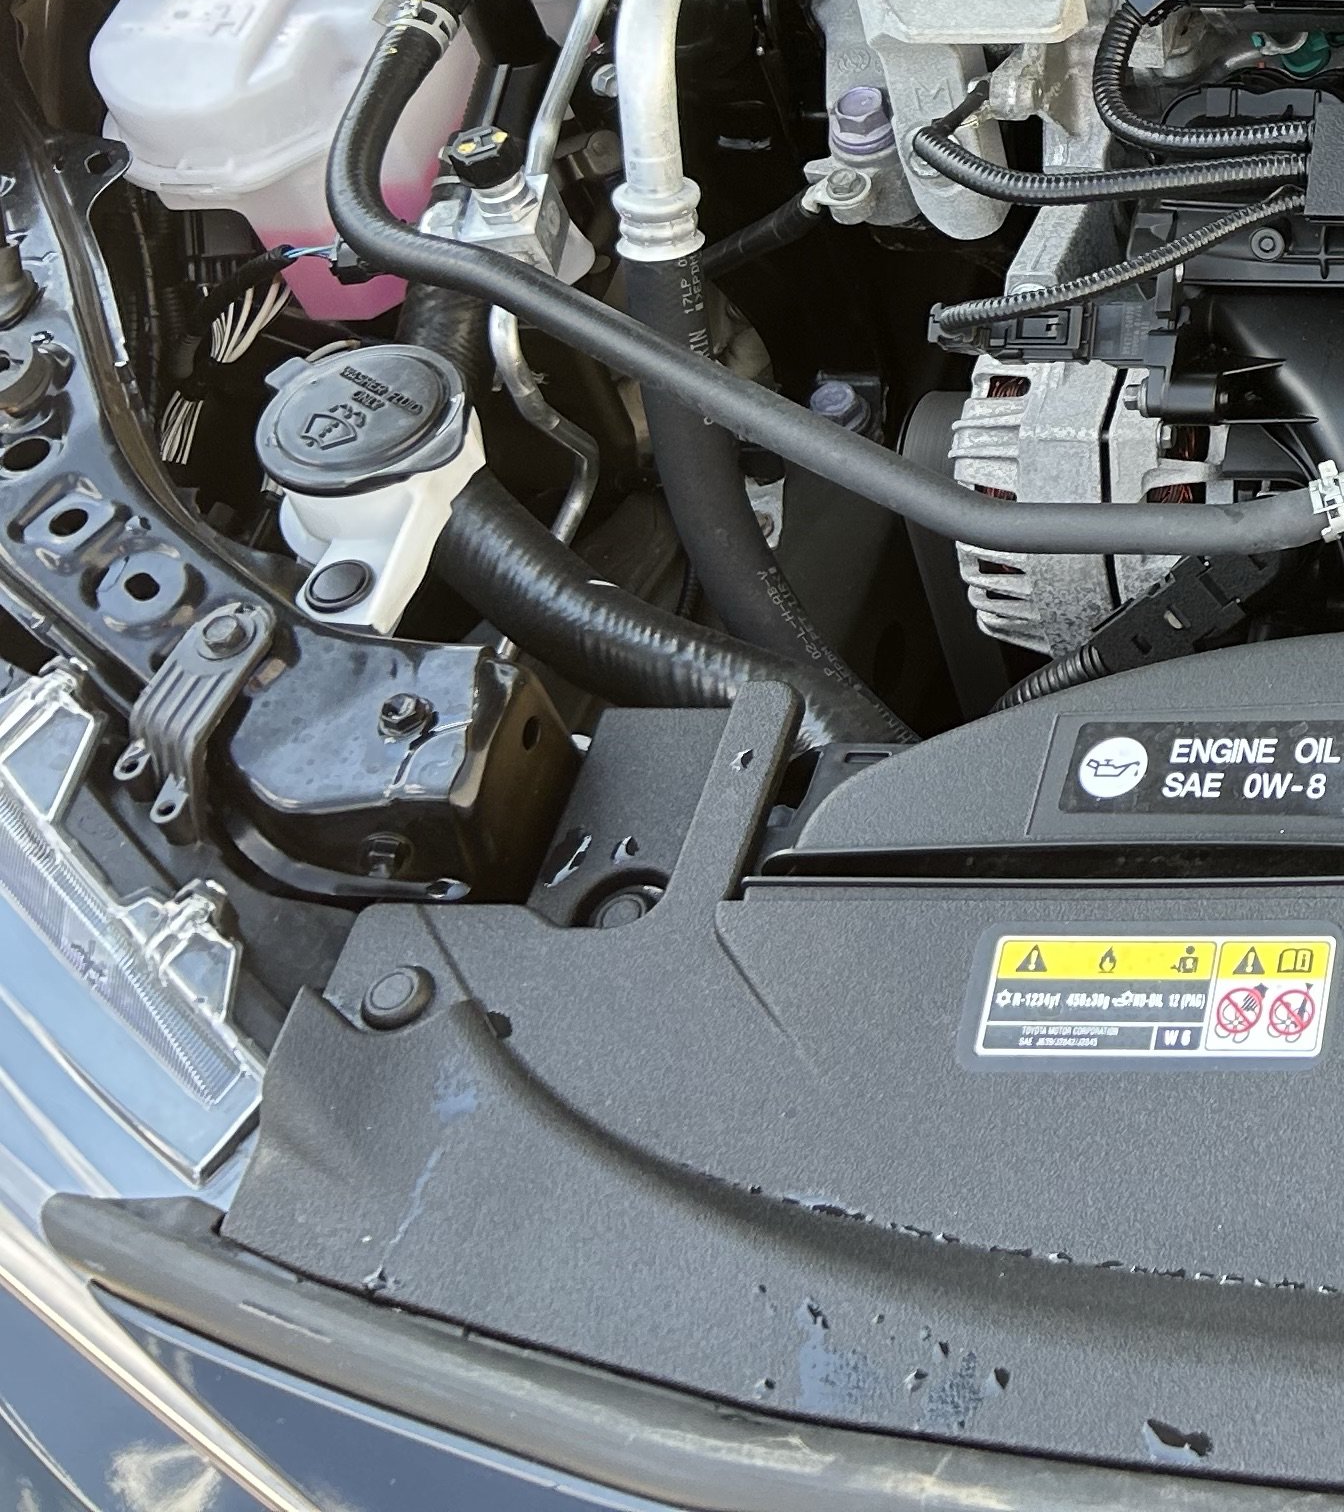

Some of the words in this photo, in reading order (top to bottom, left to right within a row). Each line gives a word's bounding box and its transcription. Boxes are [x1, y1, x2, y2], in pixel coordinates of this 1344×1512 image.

[680, 278, 695, 314] 17LP
[340, 366, 389, 397] WASHER
[386, 390, 424, 416] FLUID
[351, 390, 386, 412] ONLY
[1169, 738, 1279, 765] ENGINE
[1294, 737, 1342, 765] OIL
[1161, 771, 1225, 799] SAE
[1242, 772, 1328, 800] 0W-8
[1021, 1026, 1047, 1036] TOYOTA
[1047, 1026, 1072, 1036] MOTOR
[1072, 1026, 1120, 1037] CORPORATION
